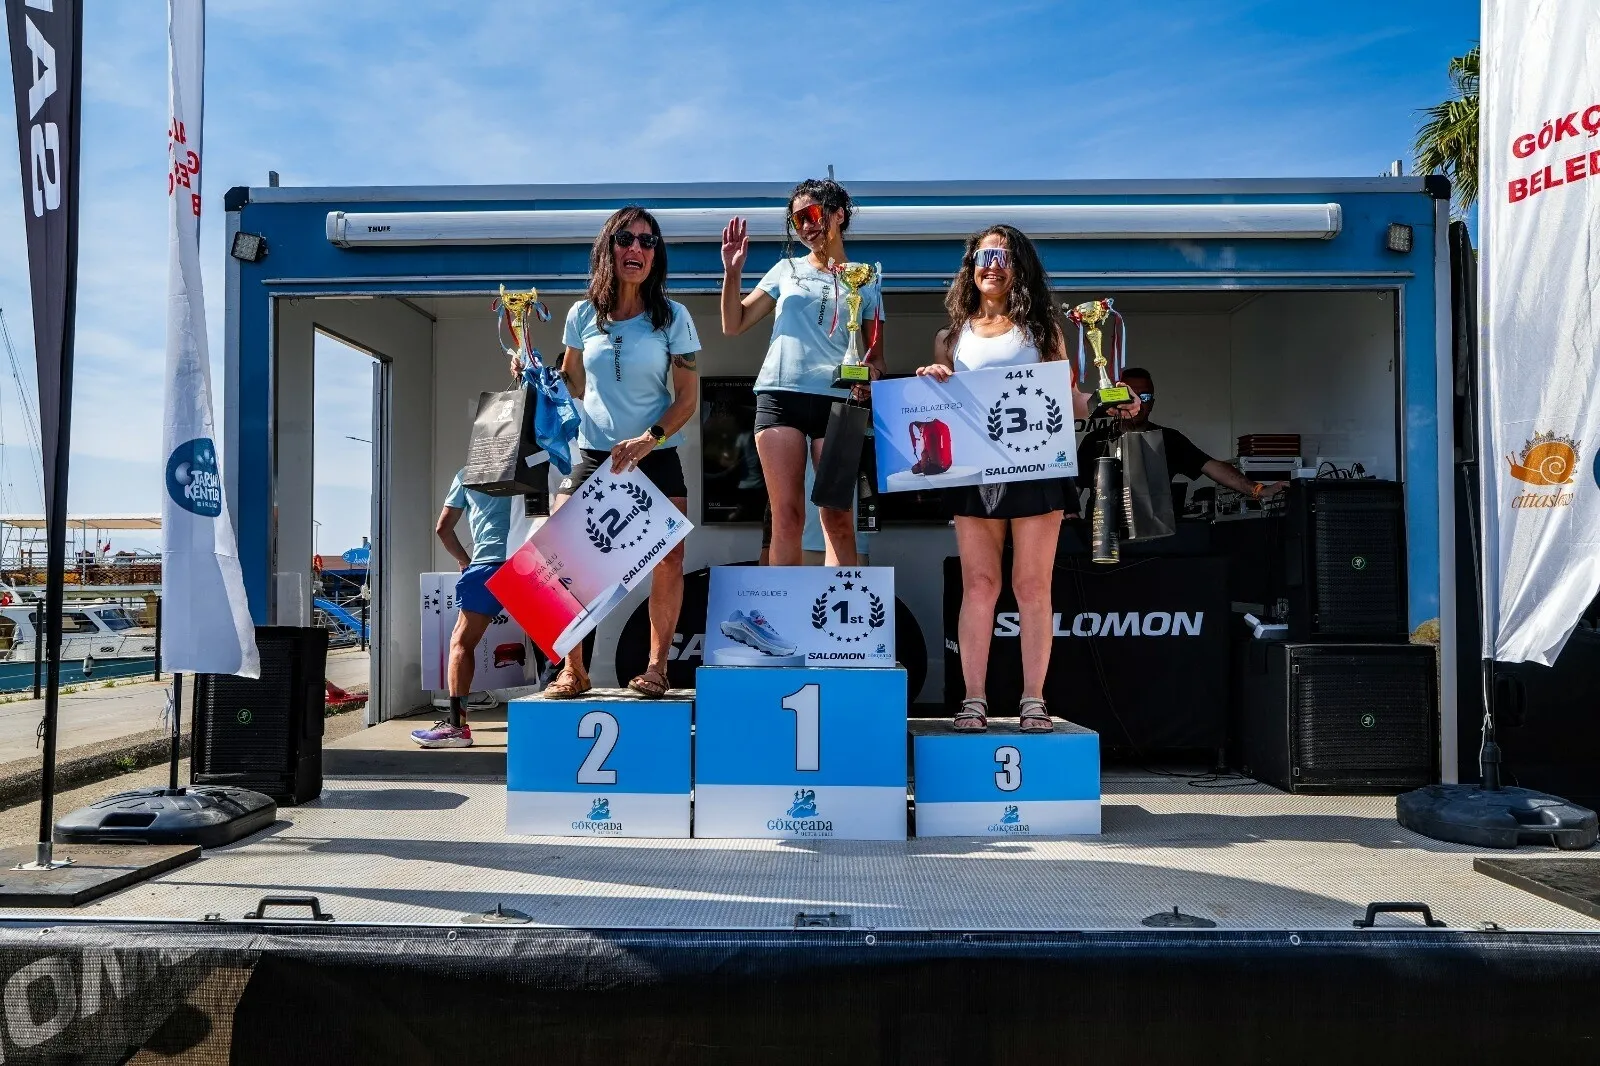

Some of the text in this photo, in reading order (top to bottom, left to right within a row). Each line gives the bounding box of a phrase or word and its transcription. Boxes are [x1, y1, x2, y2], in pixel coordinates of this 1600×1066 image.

[1004, 369, 1035, 380] 44 K
[1004, 407, 1044, 435] 3rd
[984, 463, 1046, 476] SALOMON
[581, 476, 604, 500] 44 K
[598, 504, 642, 540] 2nd
[621, 537, 668, 585] SALOMON
[835, 570, 862, 579] 44 K
[831, 600, 864, 624] 1st
[993, 611, 1204, 637] SLOMON
[808, 652, 866, 660] SALOMON
[782, 683, 820, 771] 1
[576, 710, 620, 784] 2
[994, 745, 1022, 792] 3
